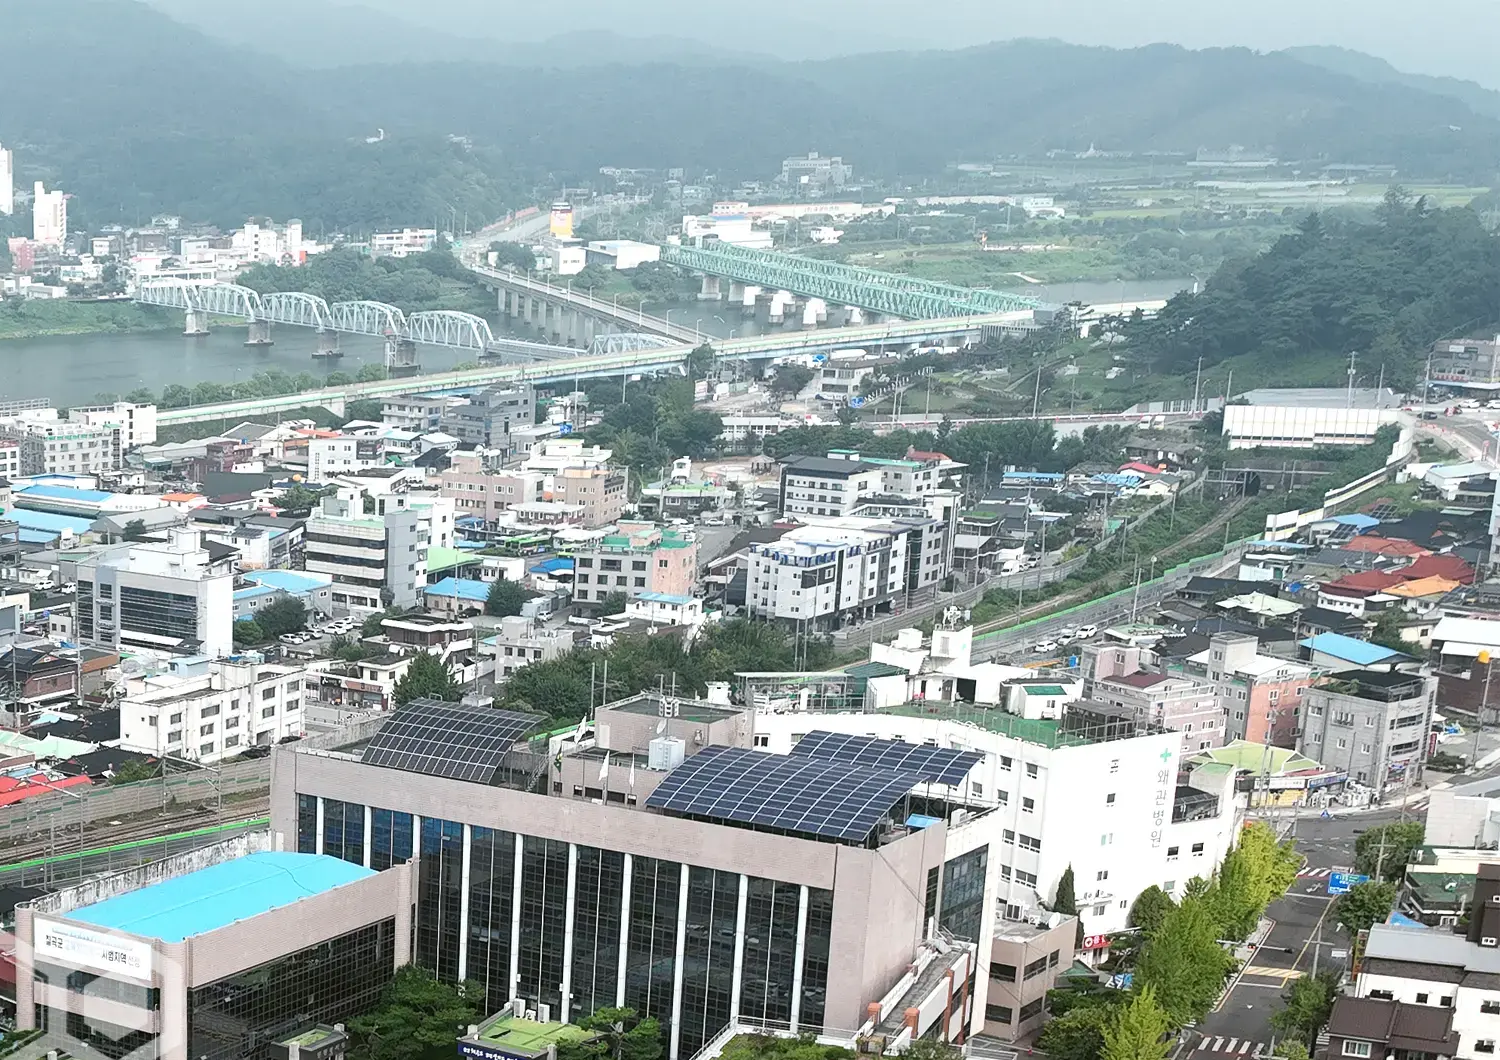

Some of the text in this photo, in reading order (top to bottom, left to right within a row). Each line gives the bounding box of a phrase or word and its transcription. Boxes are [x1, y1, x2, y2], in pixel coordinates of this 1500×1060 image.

[1150, 769, 1170, 848] 왜관병원
[45, 934, 64, 949] 칠곡군
[101, 950, 127, 965] 시범지역
